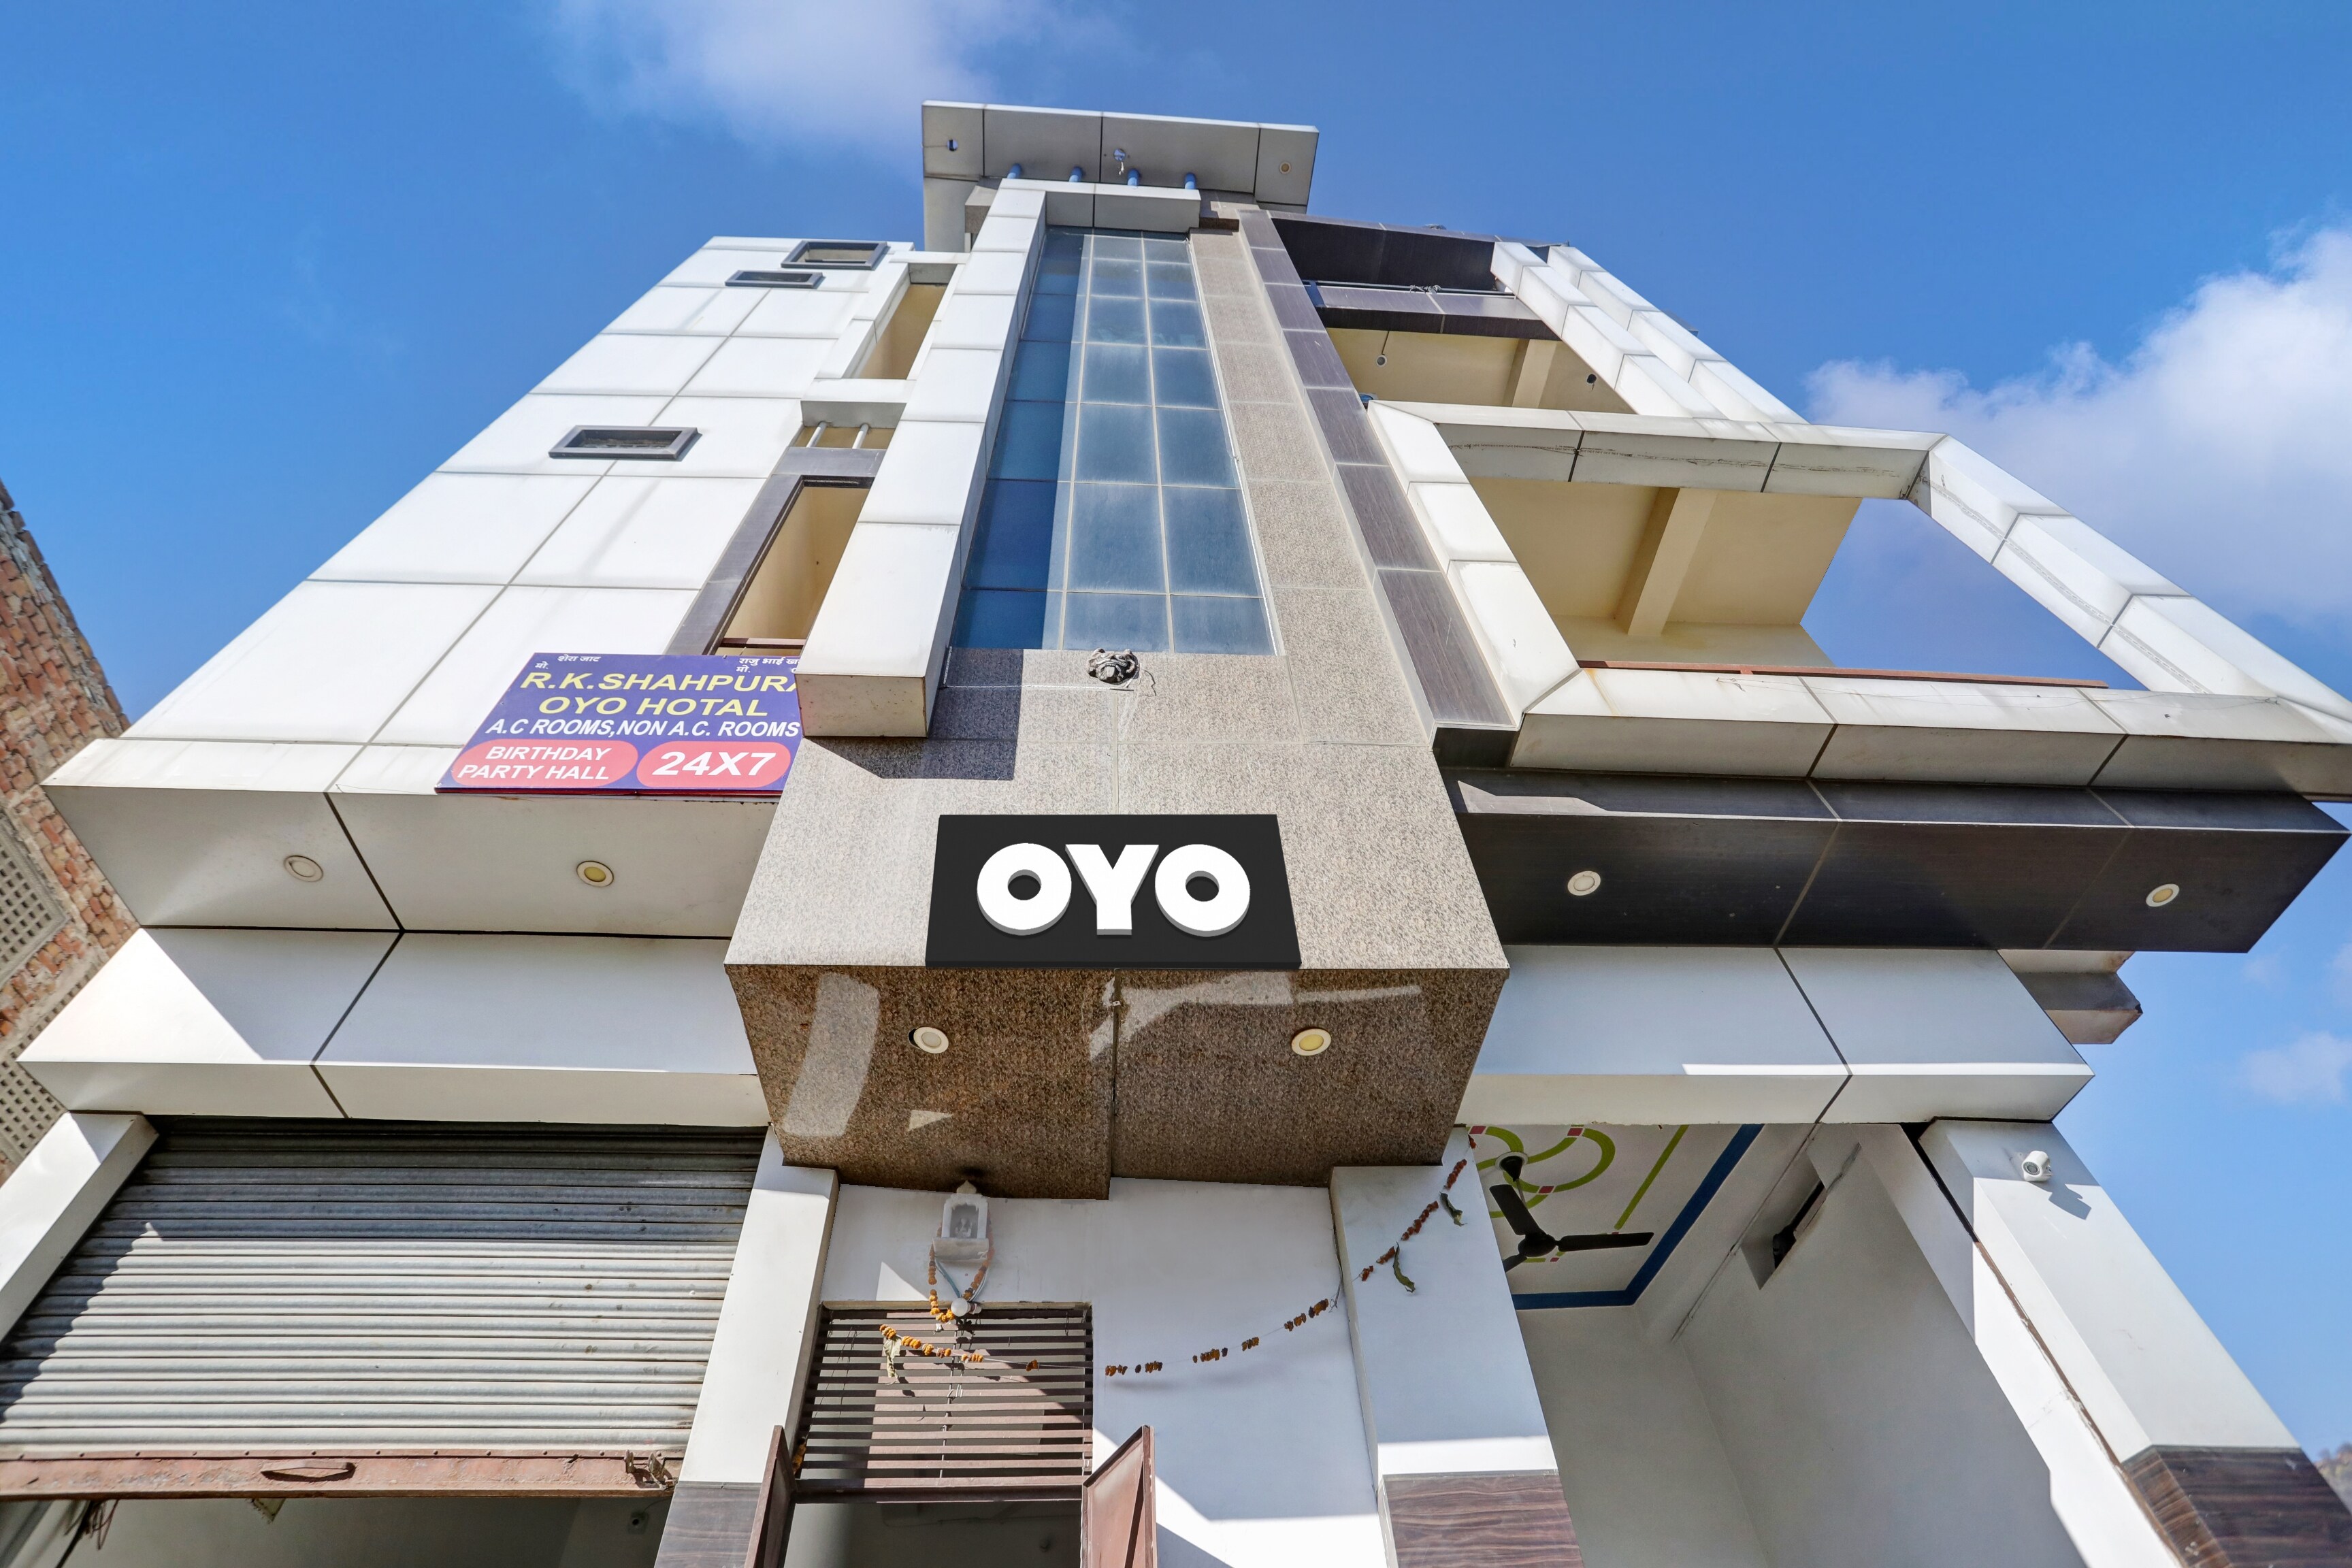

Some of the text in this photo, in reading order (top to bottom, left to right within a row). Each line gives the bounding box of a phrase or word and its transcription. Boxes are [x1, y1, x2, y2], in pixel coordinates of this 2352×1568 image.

[762, 657, 786, 666] भाई
[539, 696, 768, 716] OYO HOTAL
[485, 719, 529, 734] A.C
[668, 720, 710, 736] A.C.
[717, 721, 800, 737] ROOMS
[485, 746, 612, 761] BIRTHDAY
[458, 765, 609, 780] PARTY HALL
[651, 751, 777, 776] 24X7
[977, 843, 1250, 936] OYO
